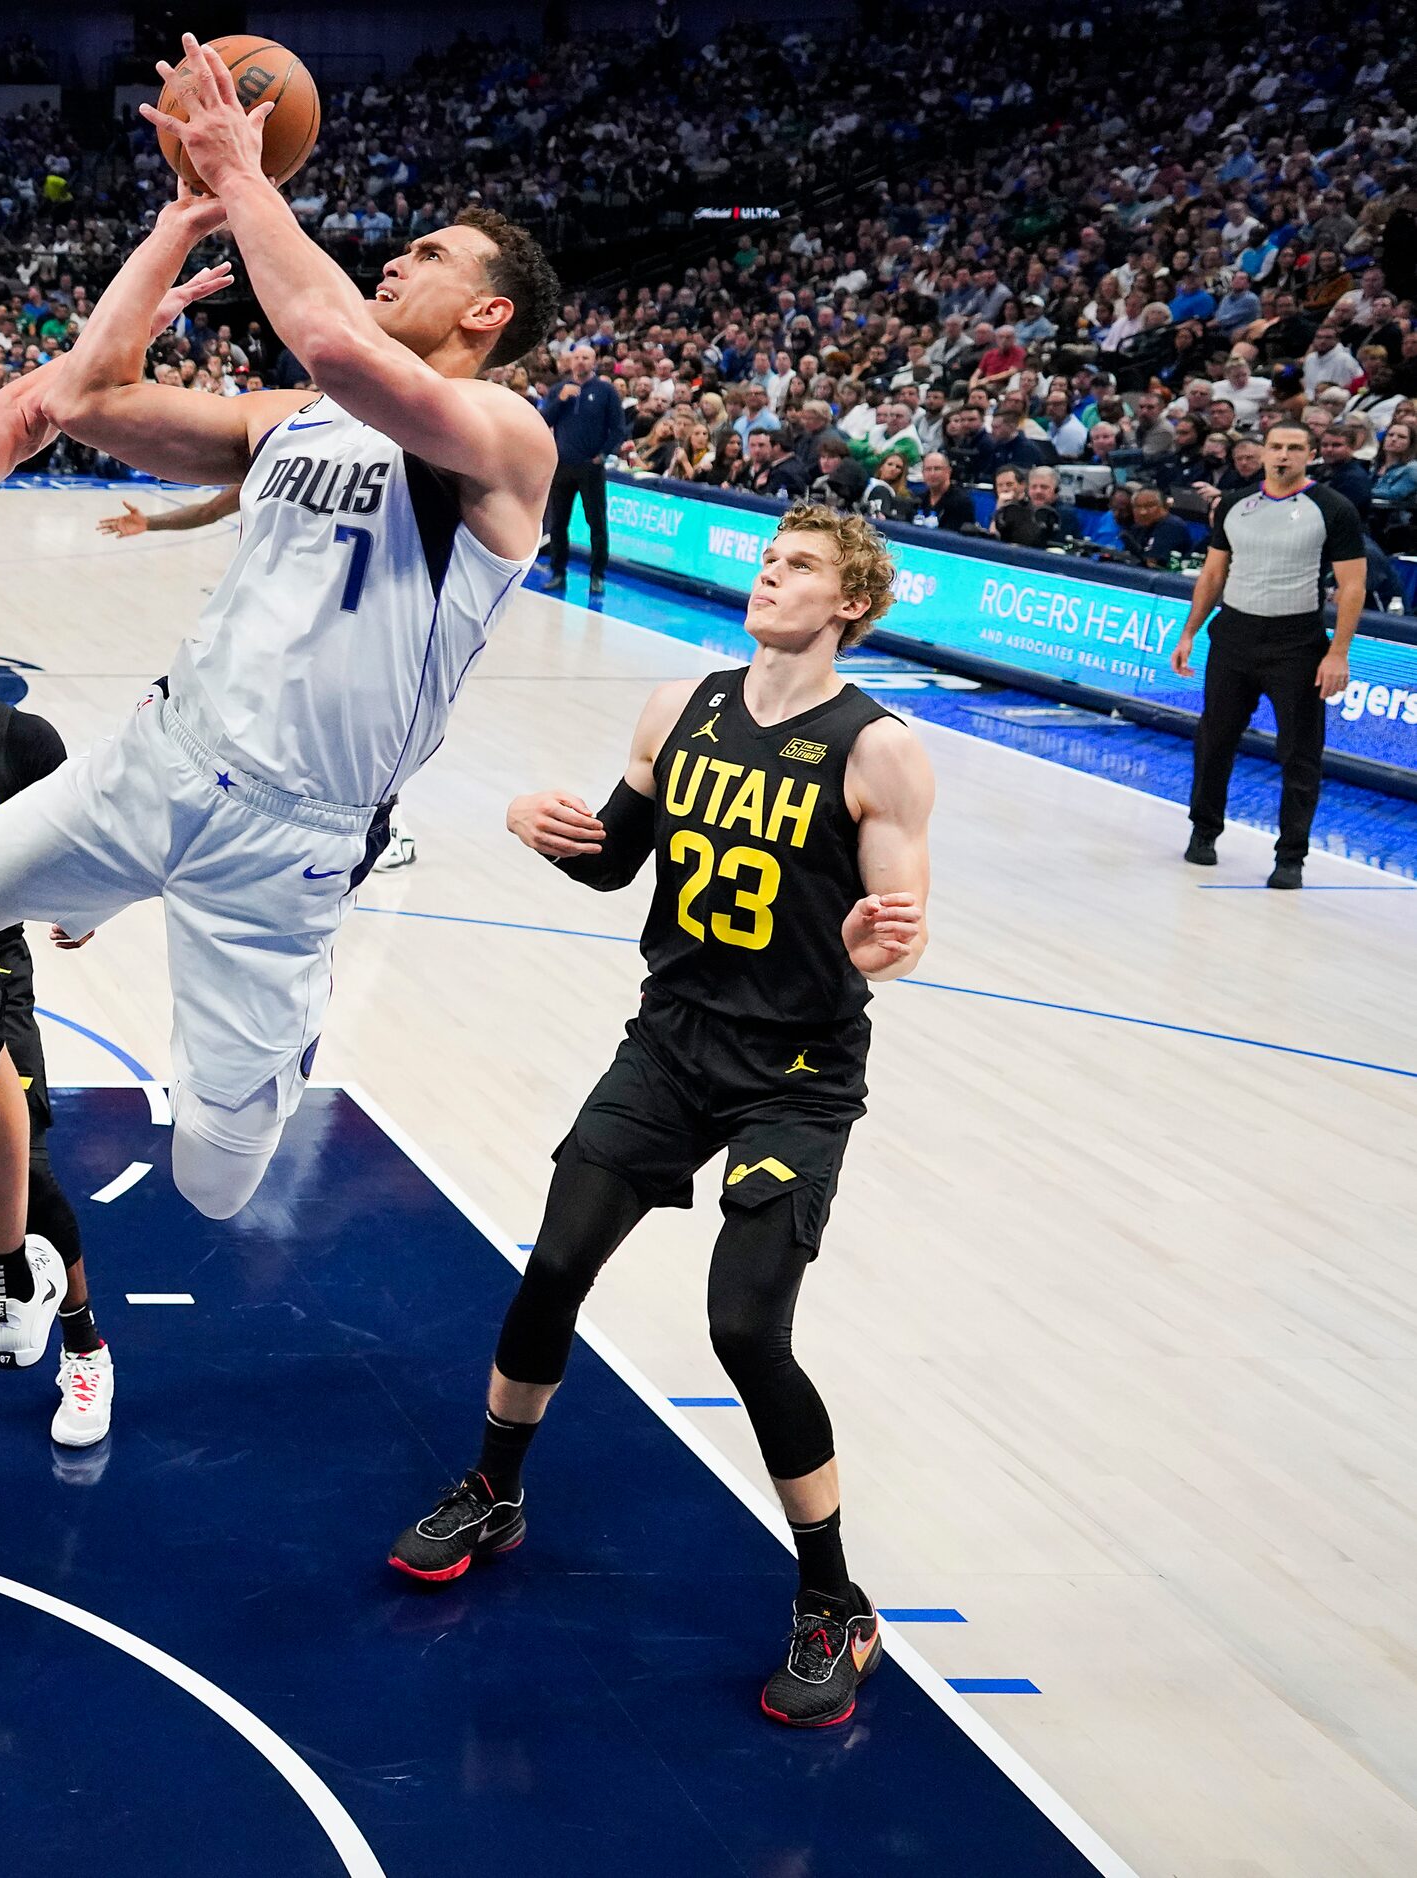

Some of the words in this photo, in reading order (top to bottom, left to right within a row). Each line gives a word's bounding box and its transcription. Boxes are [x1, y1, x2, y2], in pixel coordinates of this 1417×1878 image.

[256, 456, 390, 515] DALLAS
[641, 503, 684, 536] HEALY
[333, 524, 374, 614] 7
[979, 578, 1082, 634] ROGERS
[1083, 601, 1176, 654] HEALY
[980, 627, 1003, 644] AND
[1006, 632, 1074, 663] ASSOCIATES
[1078, 650, 1107, 672] REAL
[1111, 658, 1157, 684] ESTATE
[708, 693, 726, 708] 6
[785, 741, 801, 755] 5
[665, 749, 821, 849] UTAH
[669, 829, 781, 950] 23
